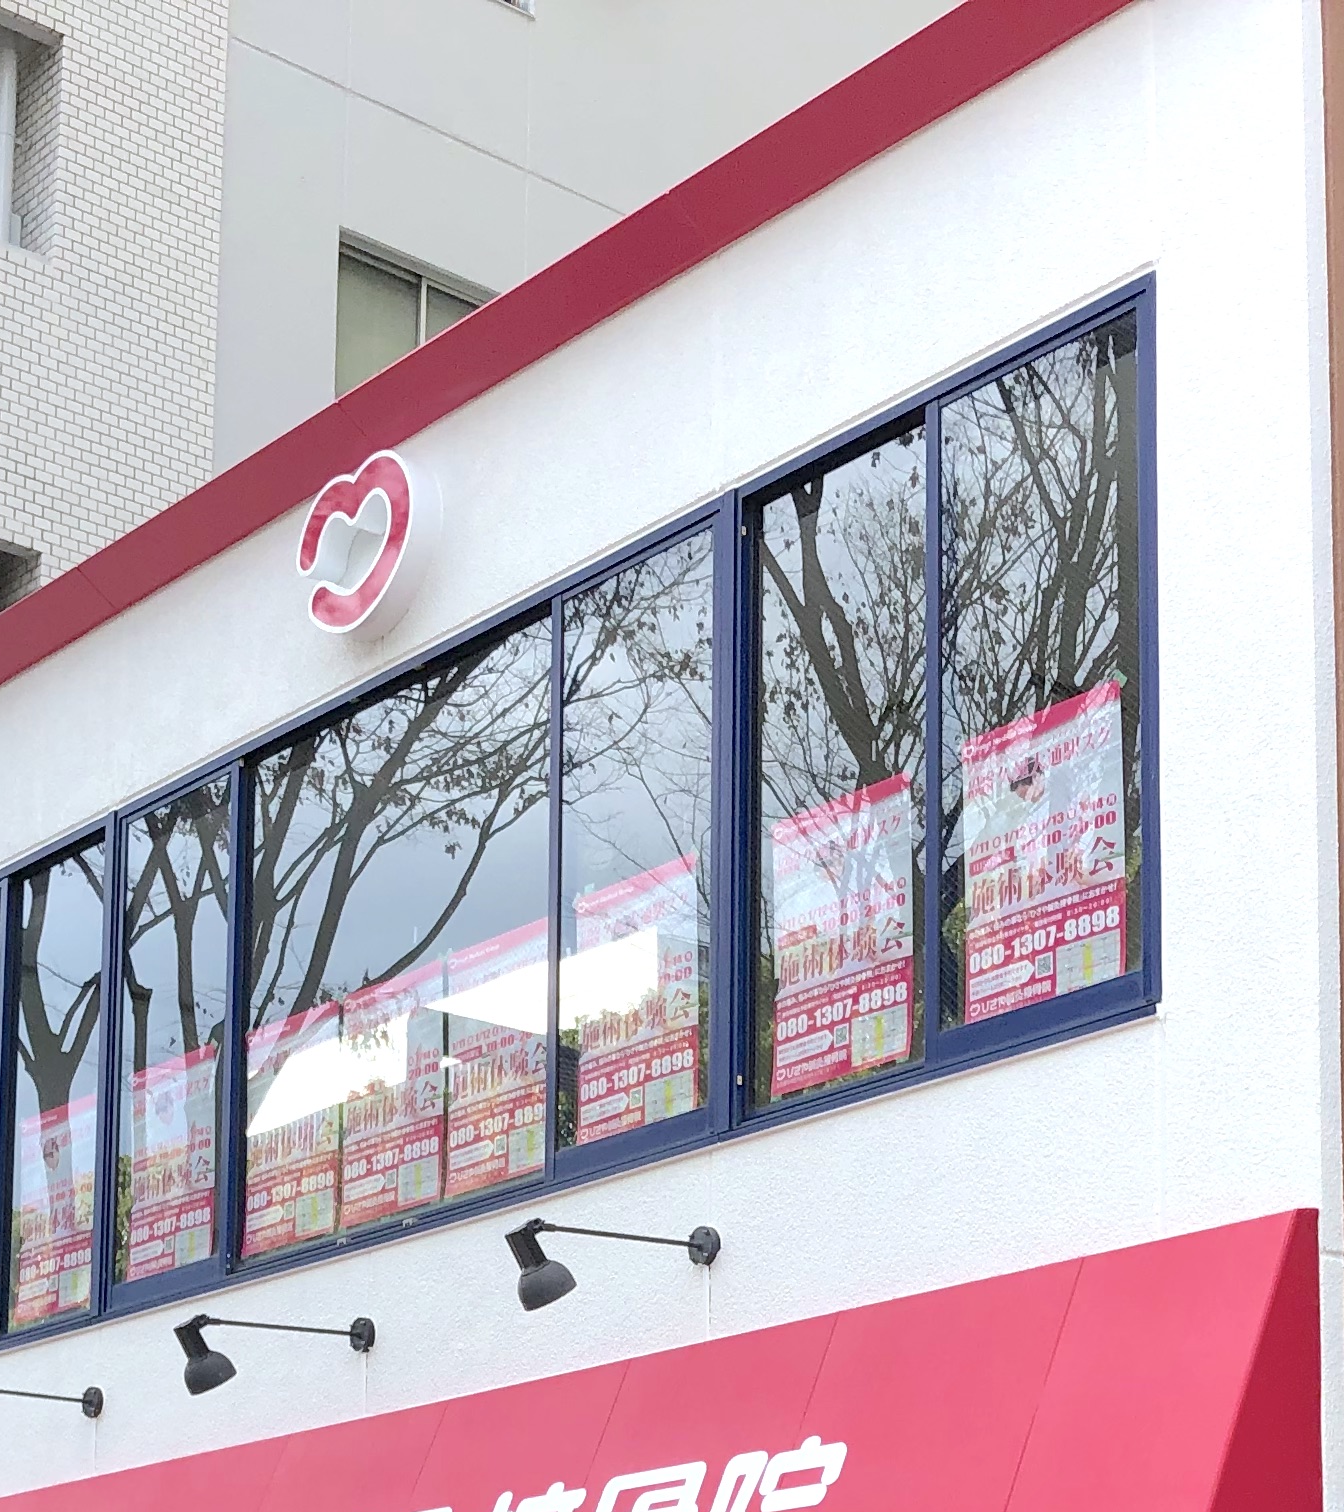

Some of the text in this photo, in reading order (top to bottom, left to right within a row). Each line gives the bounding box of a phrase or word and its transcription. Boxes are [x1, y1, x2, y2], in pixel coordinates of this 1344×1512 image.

[970, 905, 1120, 974] 080-1307-8898
[777, 981, 908, 1042] 080-1307-8898
[580, 1048, 694, 1103] 080-1307-8898
[343, 1136, 440, 1181] 080-1307-8898
